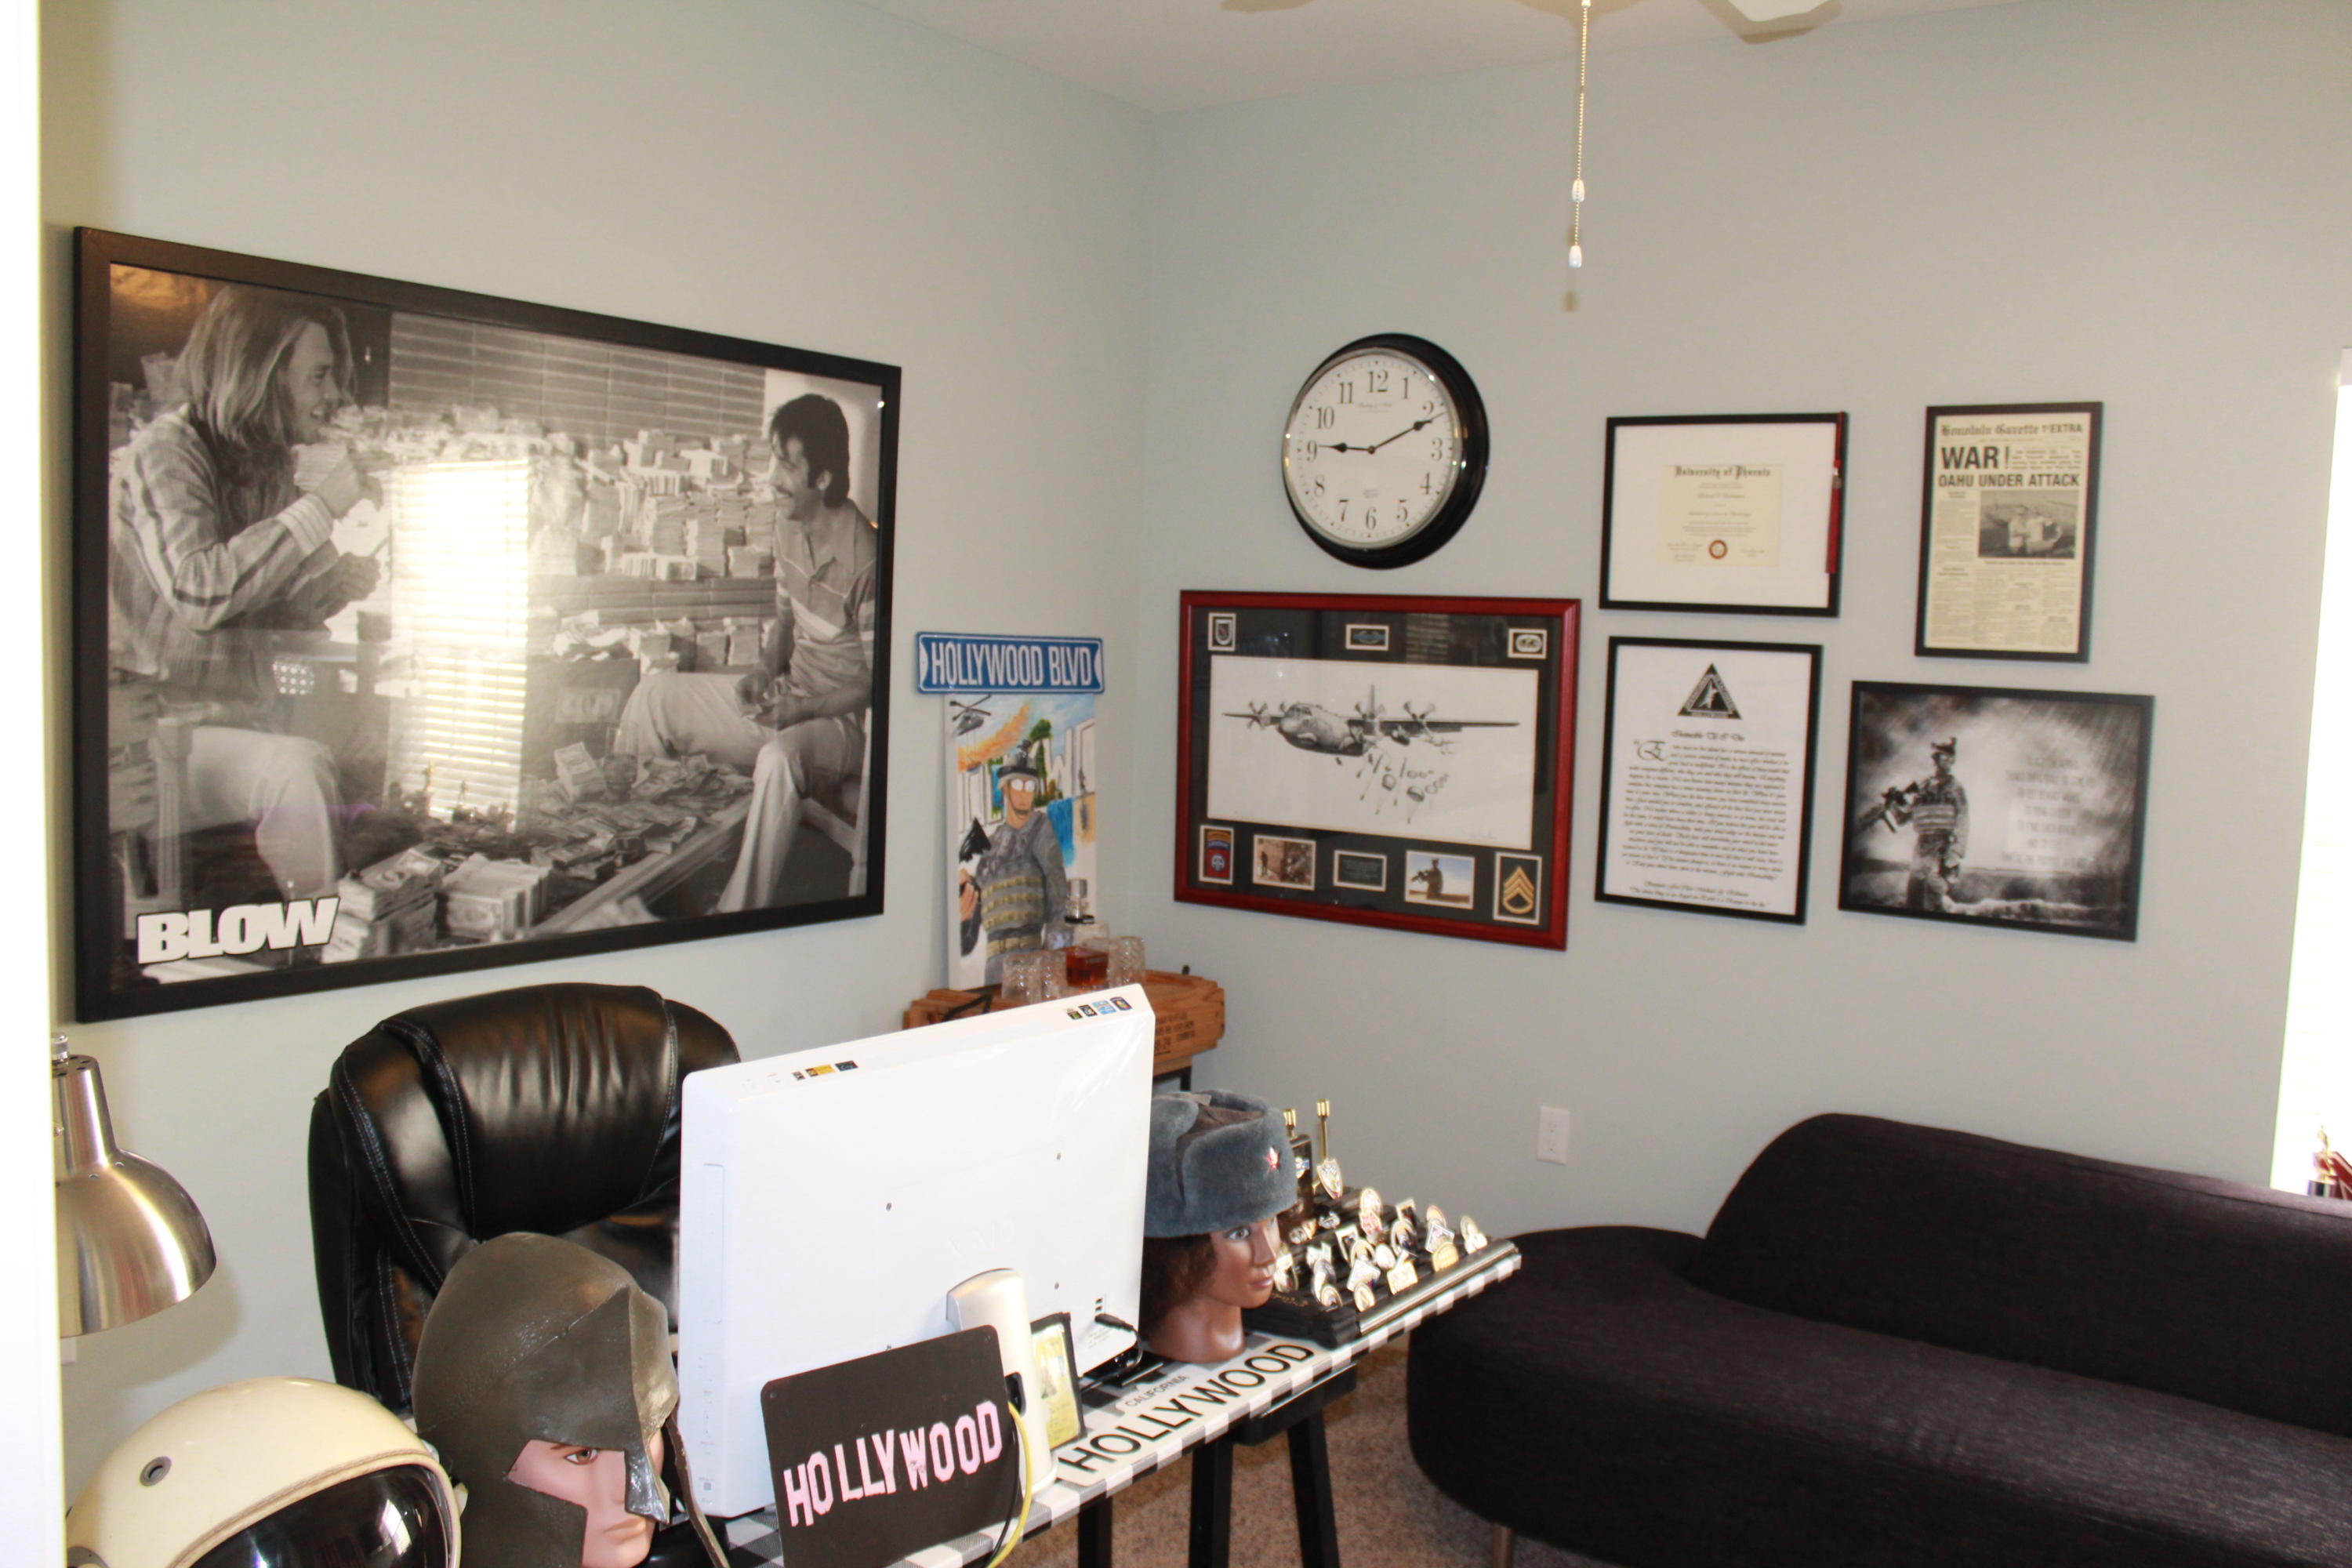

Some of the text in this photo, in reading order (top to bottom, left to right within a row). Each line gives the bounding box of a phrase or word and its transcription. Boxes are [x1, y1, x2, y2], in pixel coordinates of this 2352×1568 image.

[1338, 381, 1353, 405] 11
[1367, 369, 1388, 394] 12
[1401, 376, 1409, 400] 1
[1316, 406, 1335, 430] 10
[1422, 401, 1435, 423] 2
[1994, 423, 2039, 435] Gazette
[1306, 440, 1317, 463] 9
[1431, 437, 1443, 461] 3
[1419, 472, 1432, 495] 4
[1722, 466, 1733, 477] of
[1938, 473, 2080, 488] OAHU UNDER ATTACK
[1313, 474, 1326, 497] 8
[1338, 499, 1349, 522] 7
[1365, 507, 1377, 531] 6
[1396, 499, 1409, 523] 5
[931, 641, 1092, 687] HOLLYWOOD BLVD
[136, 896, 341, 964] BLOW
[1125, 1374, 1190, 1407] CALIFORNIA
[1058, 1344, 1315, 1473] HOLLYWOOD
[783, 1400, 1004, 1528] HOLLYWOOD
